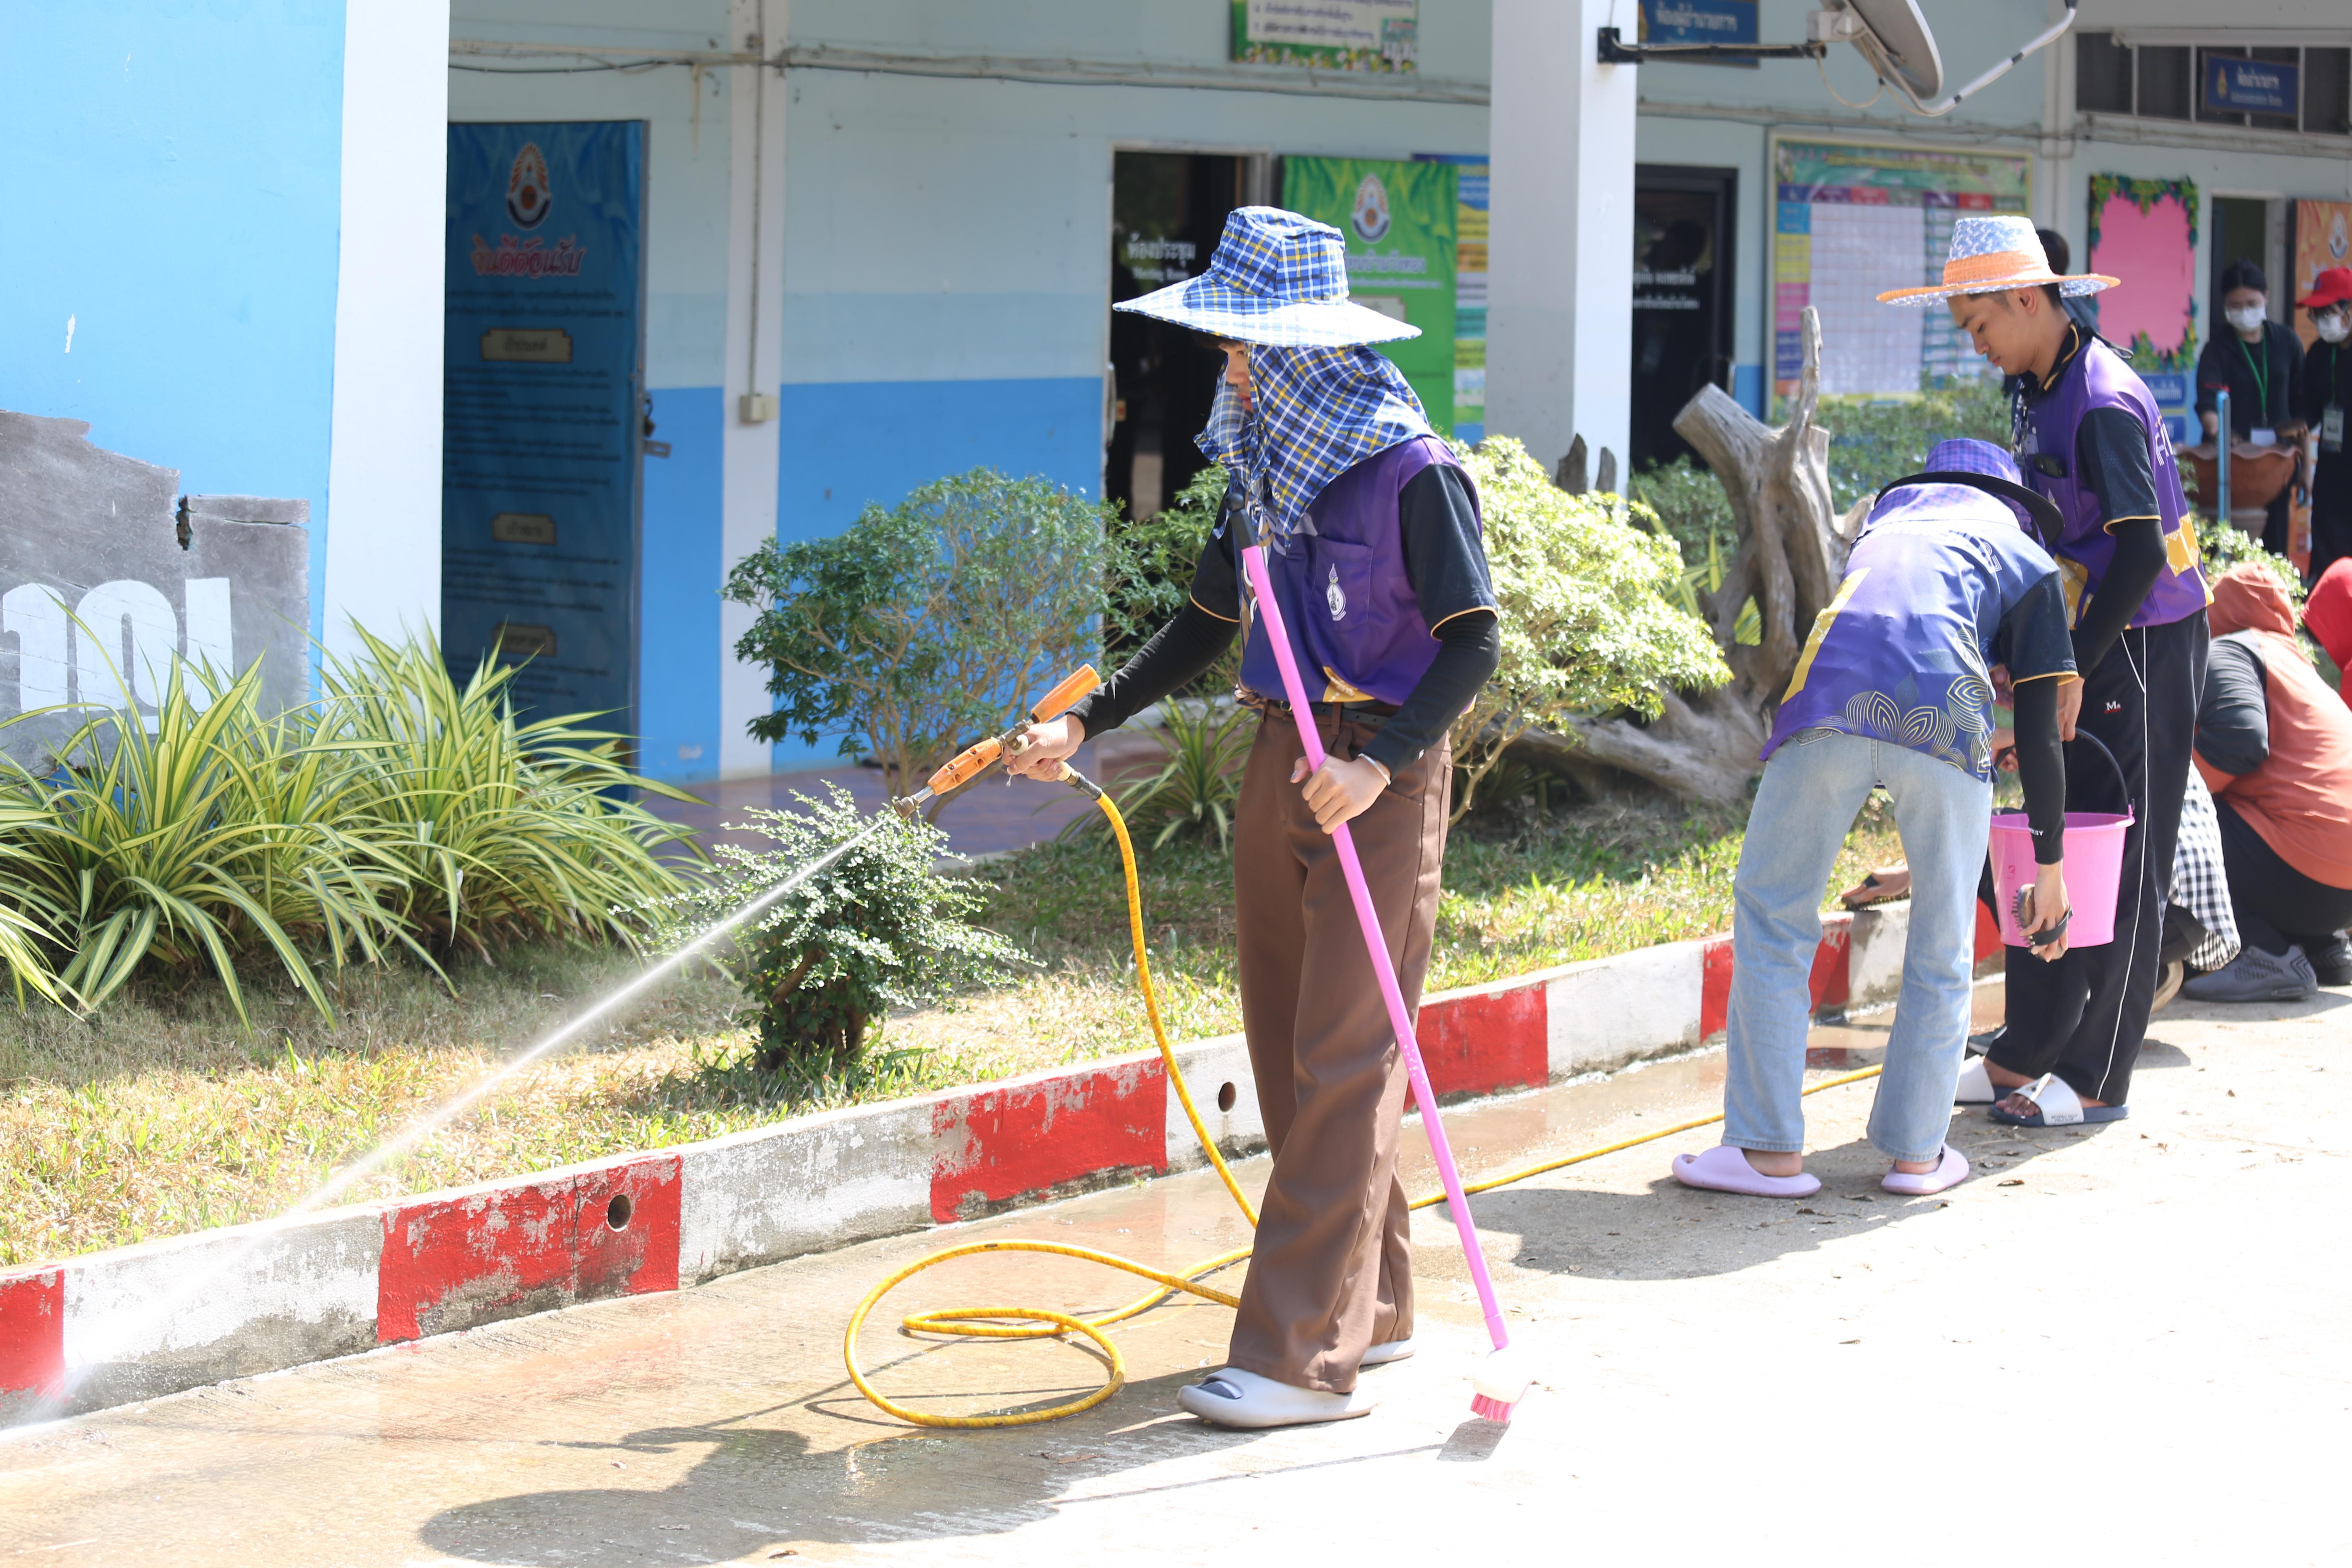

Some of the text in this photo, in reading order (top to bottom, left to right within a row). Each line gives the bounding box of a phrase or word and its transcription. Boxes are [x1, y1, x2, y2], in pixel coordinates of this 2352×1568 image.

[471, 234, 586, 278] ยินดีต้อนรับ
[1127, 231, 1196, 268] ห้องประชุม
